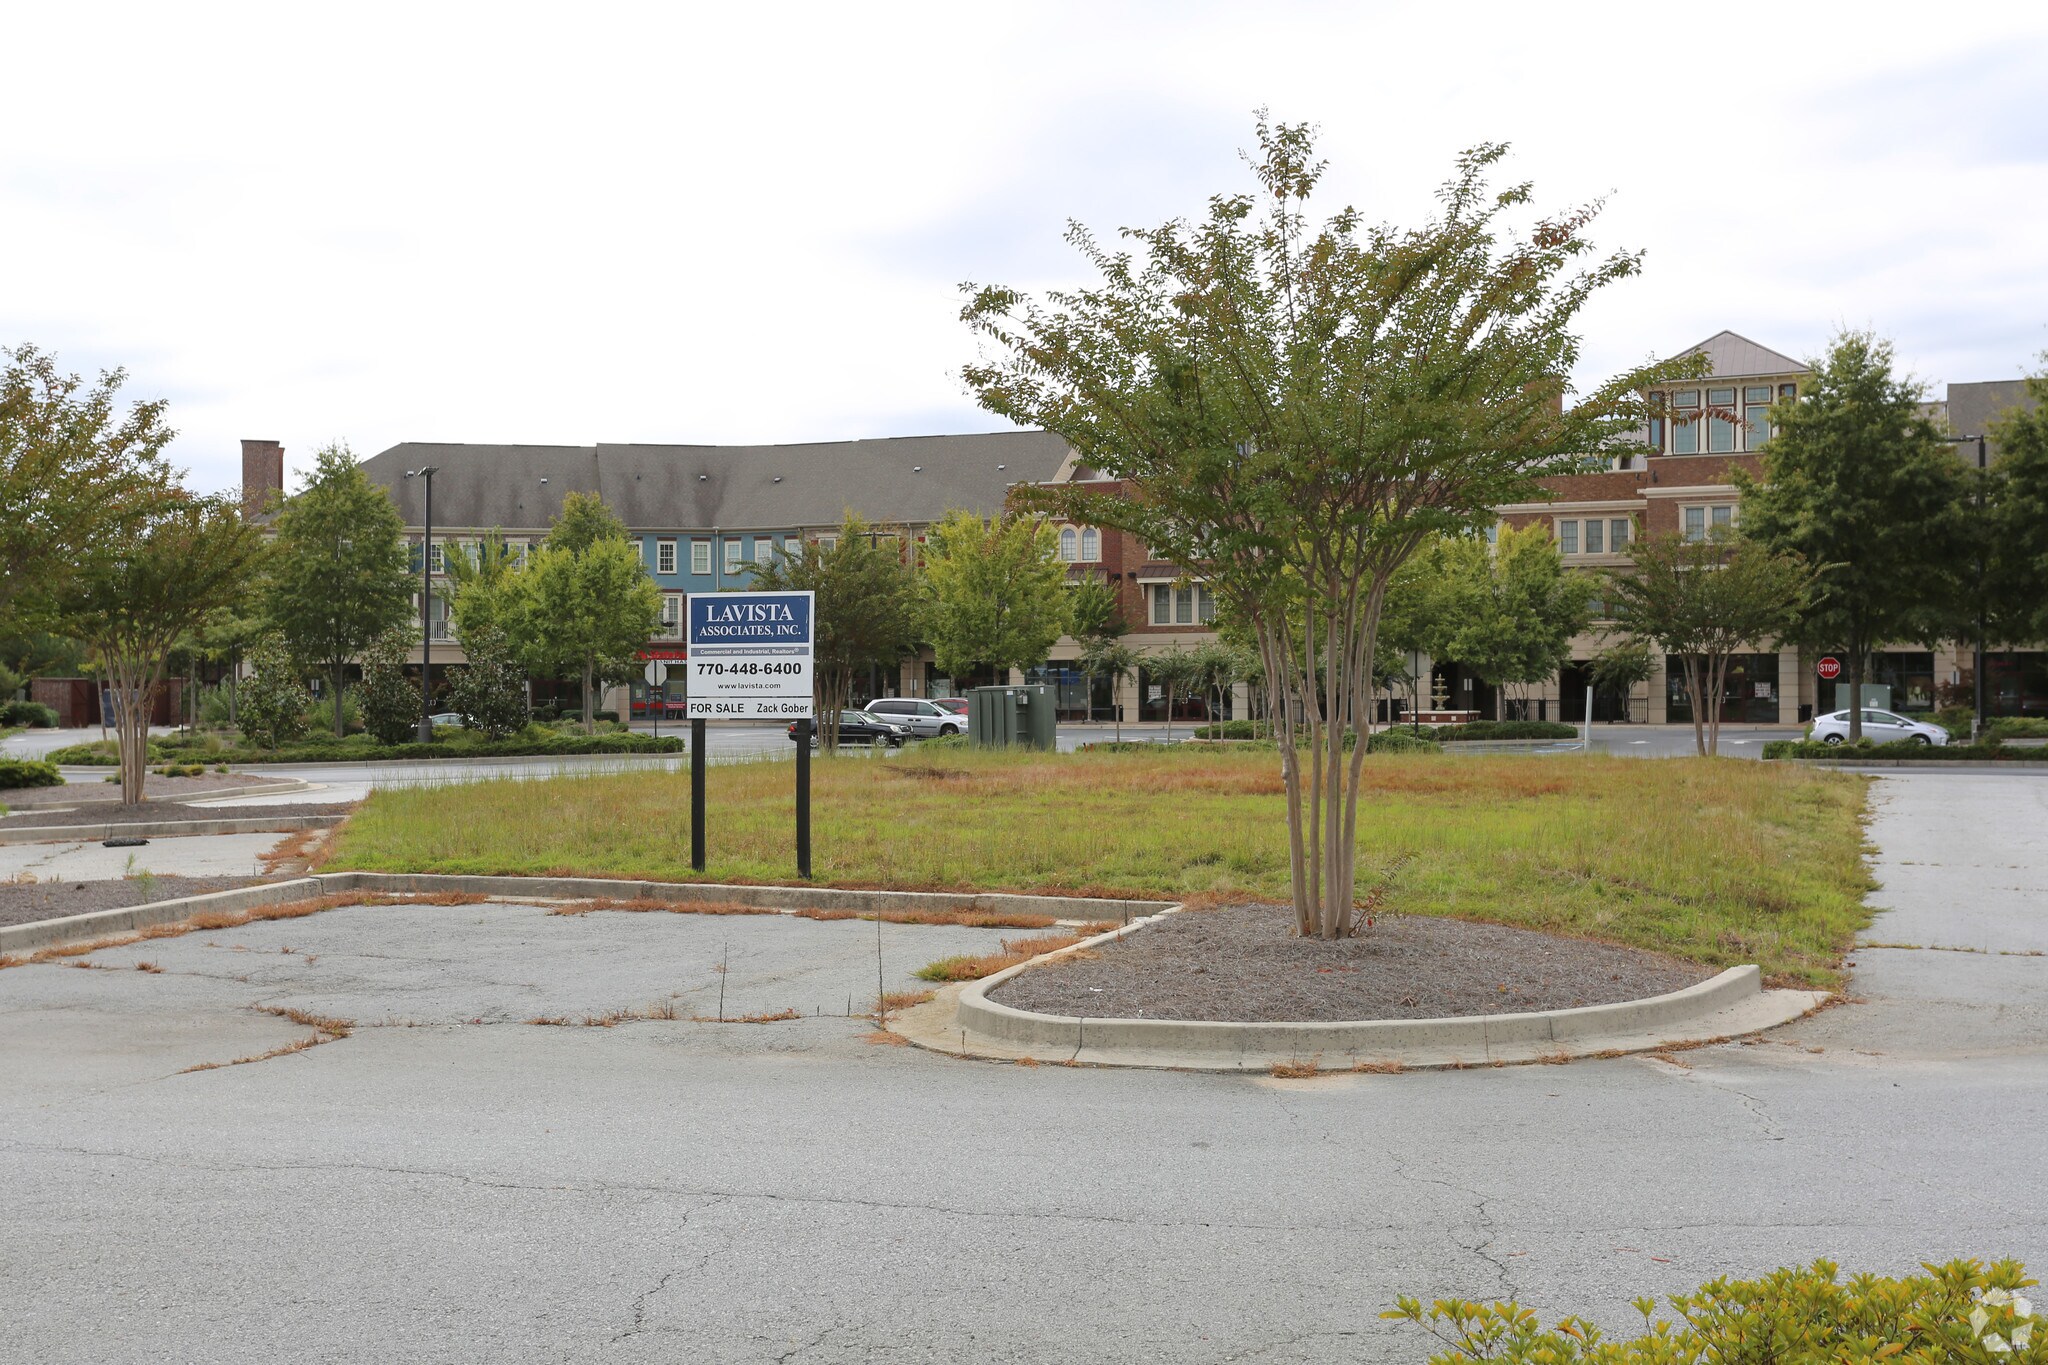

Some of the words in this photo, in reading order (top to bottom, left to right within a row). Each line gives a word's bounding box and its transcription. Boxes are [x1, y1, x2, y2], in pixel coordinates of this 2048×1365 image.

[706, 603, 794, 622] LAVISTA
[699, 625, 774, 637] ASSOCIATES,
[777, 624, 801, 635] INC.
[697, 663, 802, 675] 770-448-6400
[1820, 664, 1838, 672] STOP
[690, 703, 712, 713] FOR
[716, 703, 744, 713] SALE
[757, 703, 778, 713] Zack
[781, 703, 808, 713] Gober
